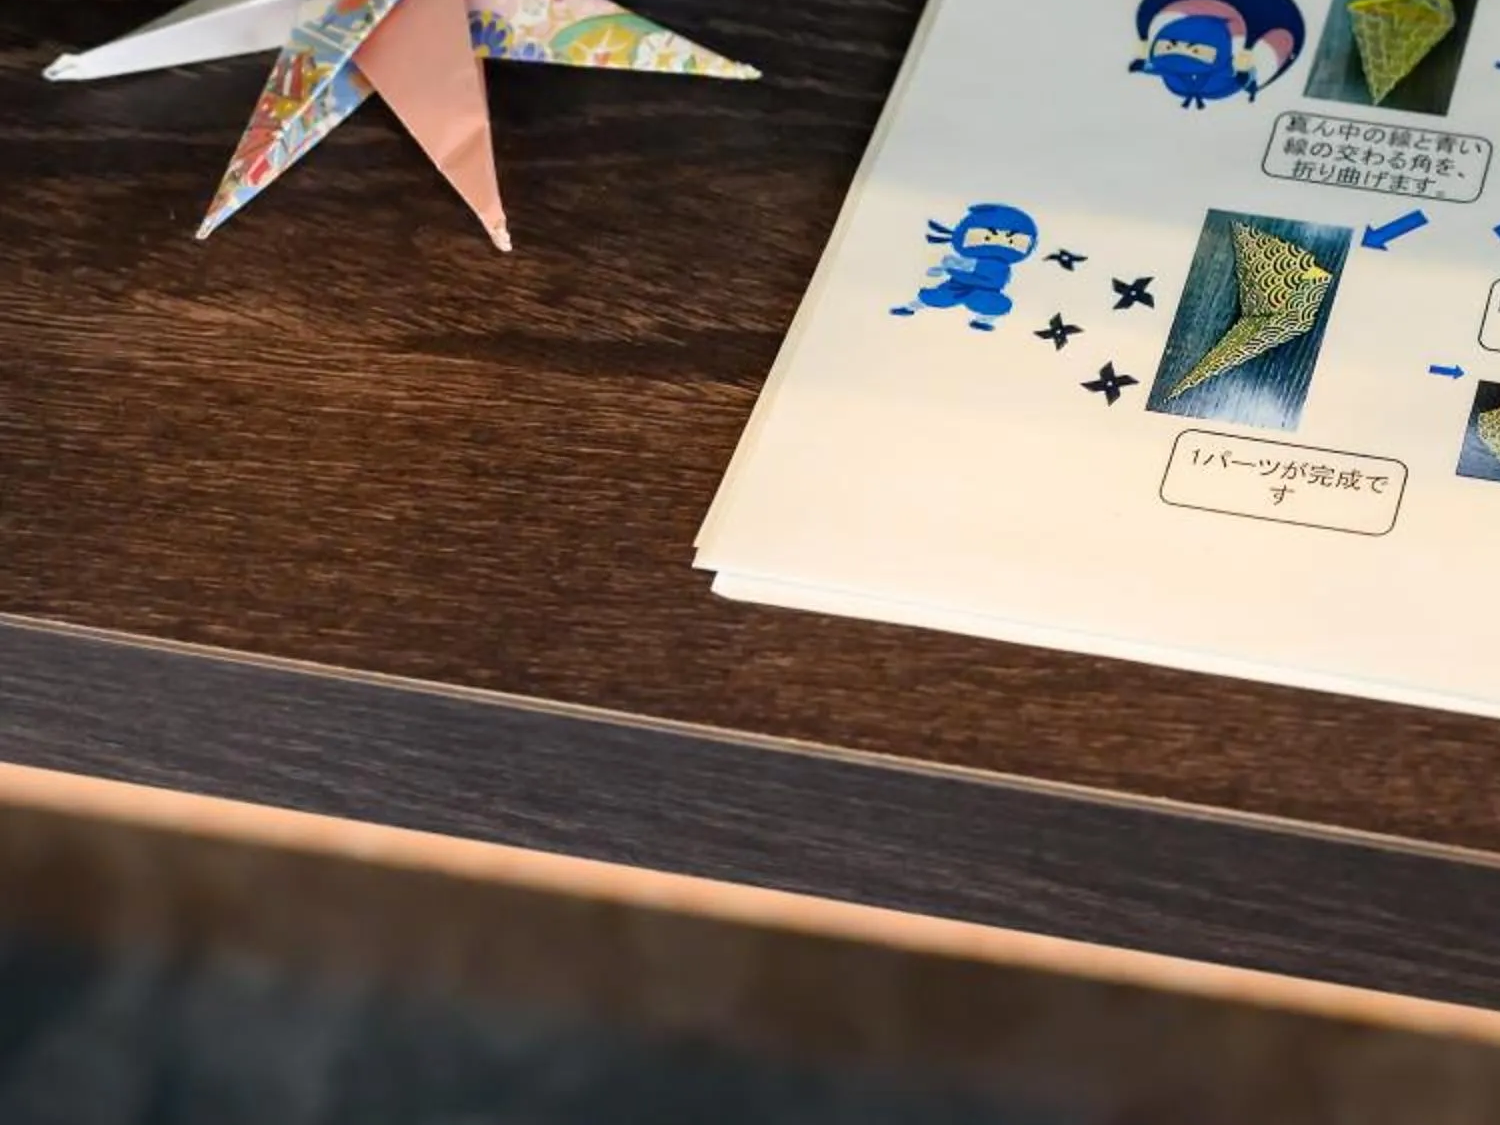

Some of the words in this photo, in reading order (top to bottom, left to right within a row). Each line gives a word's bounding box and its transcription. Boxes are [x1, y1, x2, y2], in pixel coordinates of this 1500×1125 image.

[1285, 115, 1482, 154] 真ん中の線と青い
[1283, 137, 1465, 178] 線の交わる角を、
[1292, 160, 1446, 198] 折り曲げます。
[1191, 448, 1388, 493] 1パーツが完成で
[1269, 484, 1295, 505] す
